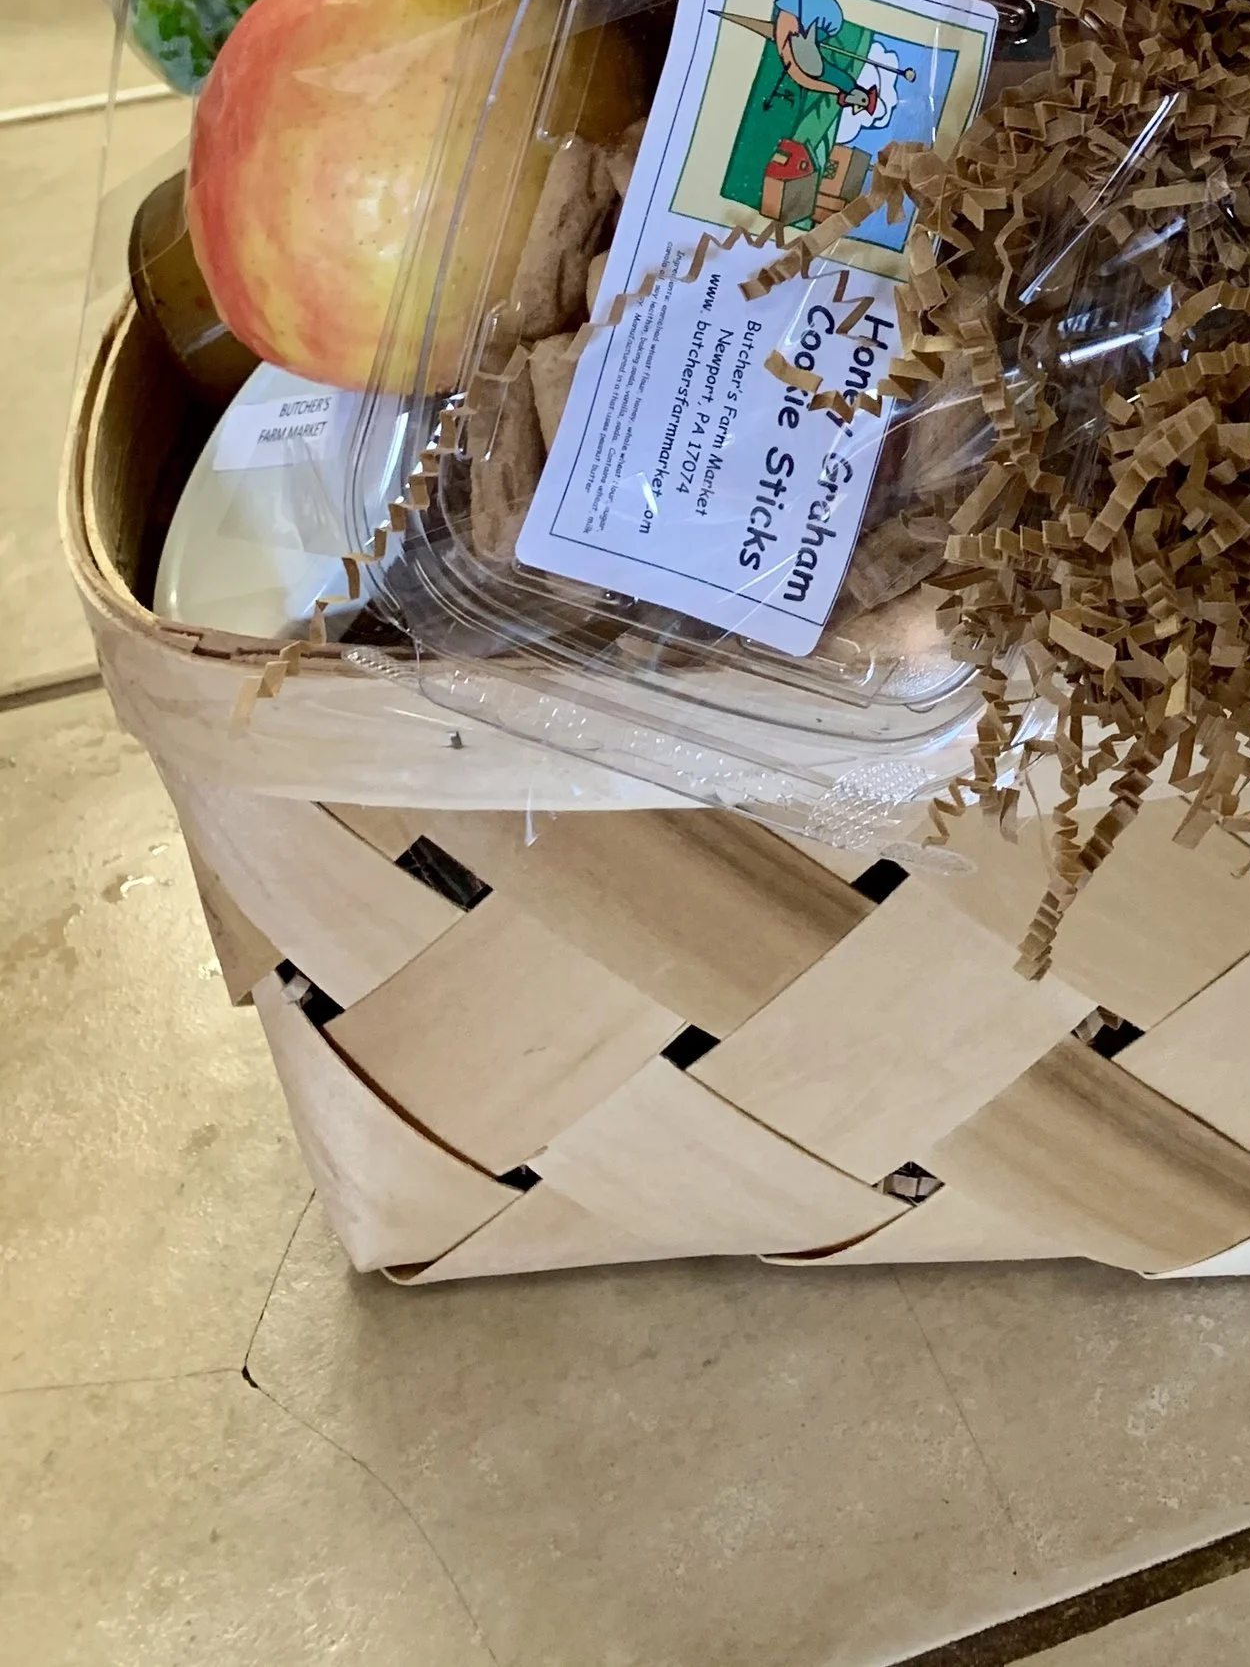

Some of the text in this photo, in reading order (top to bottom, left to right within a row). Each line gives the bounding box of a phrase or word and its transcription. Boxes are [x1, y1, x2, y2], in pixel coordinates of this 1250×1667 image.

[257, 421, 328, 444] FARM MARKET
[615, 453, 625, 477] wheat
[676, 329, 731, 493] Newport, PA 17074
[694, 320, 760, 516] Butcher's Farm Market
[739, 447, 797, 571] Sticks
[785, 452, 854, 605] Graham
